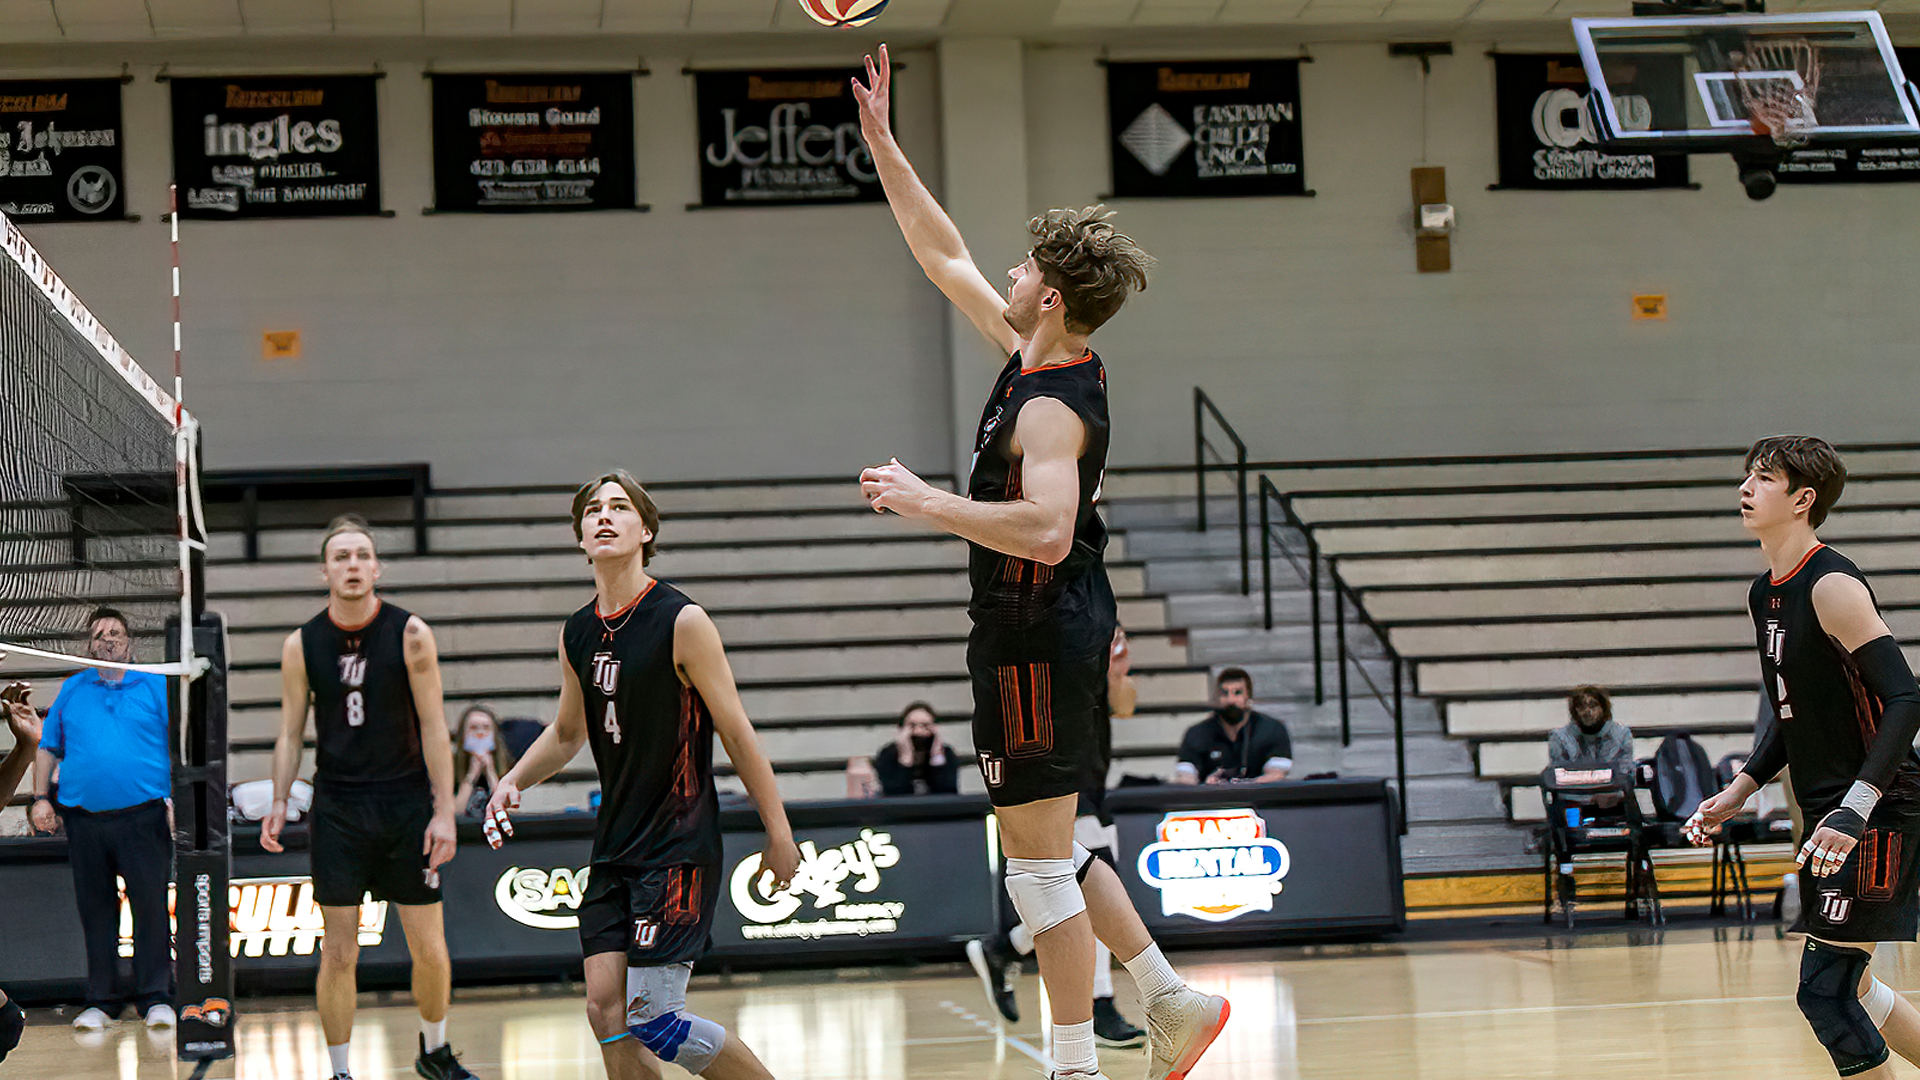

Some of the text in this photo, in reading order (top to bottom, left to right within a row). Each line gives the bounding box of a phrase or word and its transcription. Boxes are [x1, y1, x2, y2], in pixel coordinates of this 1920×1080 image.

[204, 114, 343, 160] ingles
[591, 651, 622, 697] TU
[346, 690, 366, 728] 8
[603, 700, 622, 745] 4
[977, 751, 1005, 789] TU
[1819, 888, 1854, 925] TU
[633, 915, 661, 950] TU
